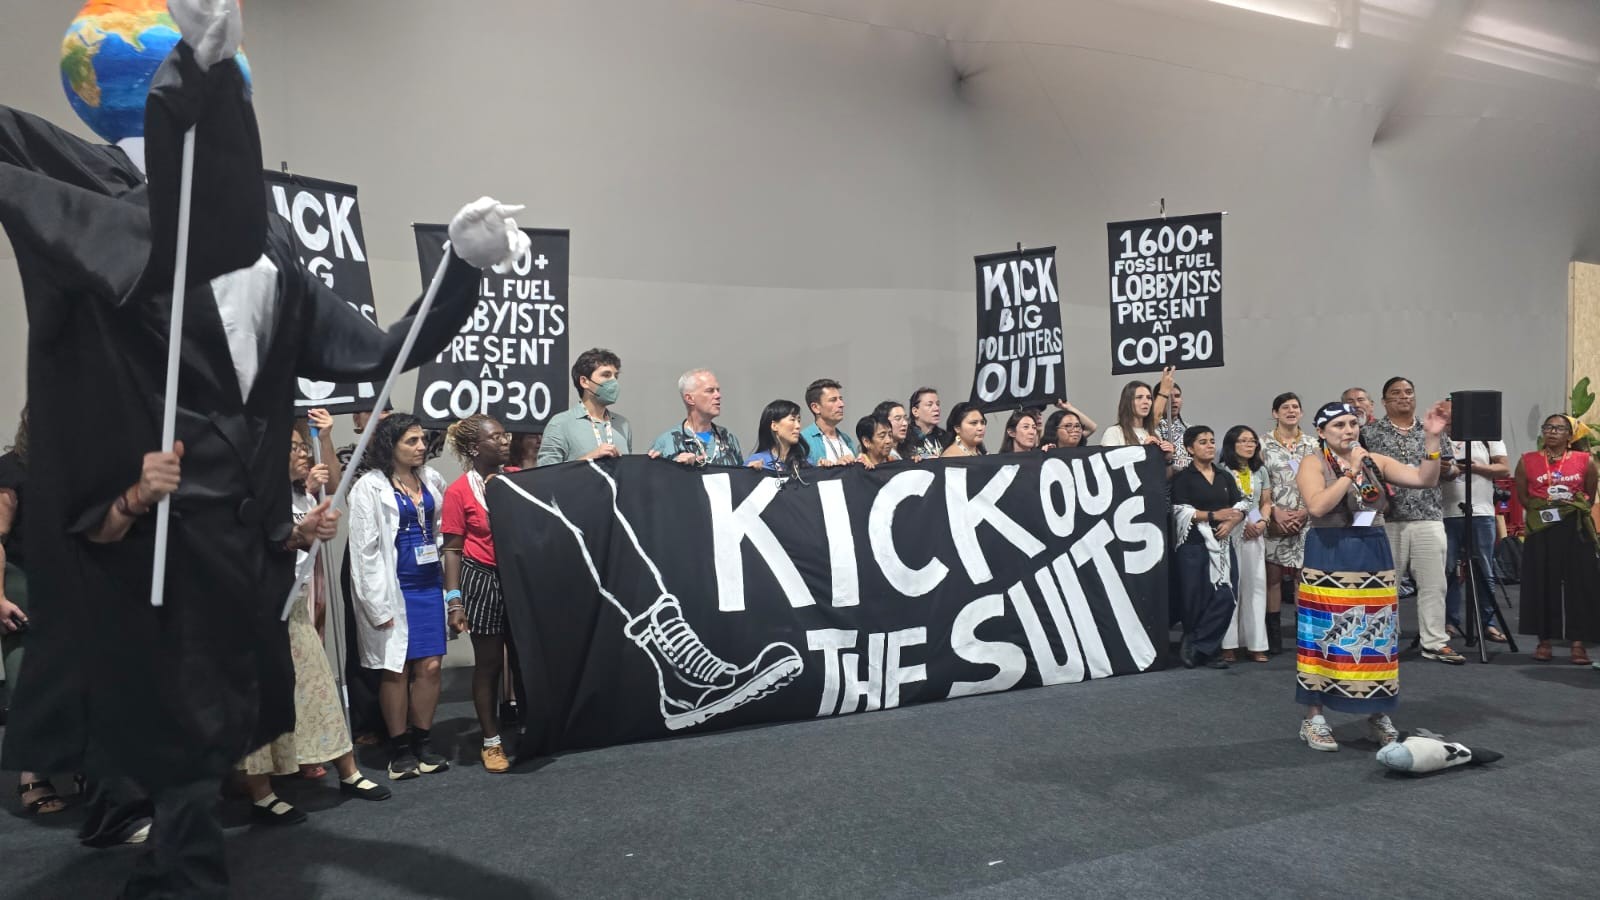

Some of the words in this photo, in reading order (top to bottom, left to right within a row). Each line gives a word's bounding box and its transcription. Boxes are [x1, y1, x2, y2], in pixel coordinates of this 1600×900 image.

[272, 185, 366, 262] ICK
[1119, 225, 1213, 259] 1600+
[1114, 256, 1173, 275] FOSSIL
[1175, 252, 1215, 270] FUEL
[503, 279, 555, 300] FUEL
[983, 257, 1058, 311] KICK
[1111, 269, 1221, 303] LOBBYISTS
[459, 299, 565, 336] BYISTS
[999, 304, 1043, 333] BIG
[1117, 296, 1210, 325] PRESENT
[1152, 320, 1172, 334] AT
[978, 327, 1063, 364] POLLUTERS
[1117, 330, 1213, 367] COP30
[479, 363, 508, 379] AT
[977, 354, 1061, 403] OUT
[422, 379, 551, 421] COP30
[702, 464, 1047, 612] KICK
[1039, 446, 1147, 538] OUT
[946, 496, 1166, 699] SUITS
